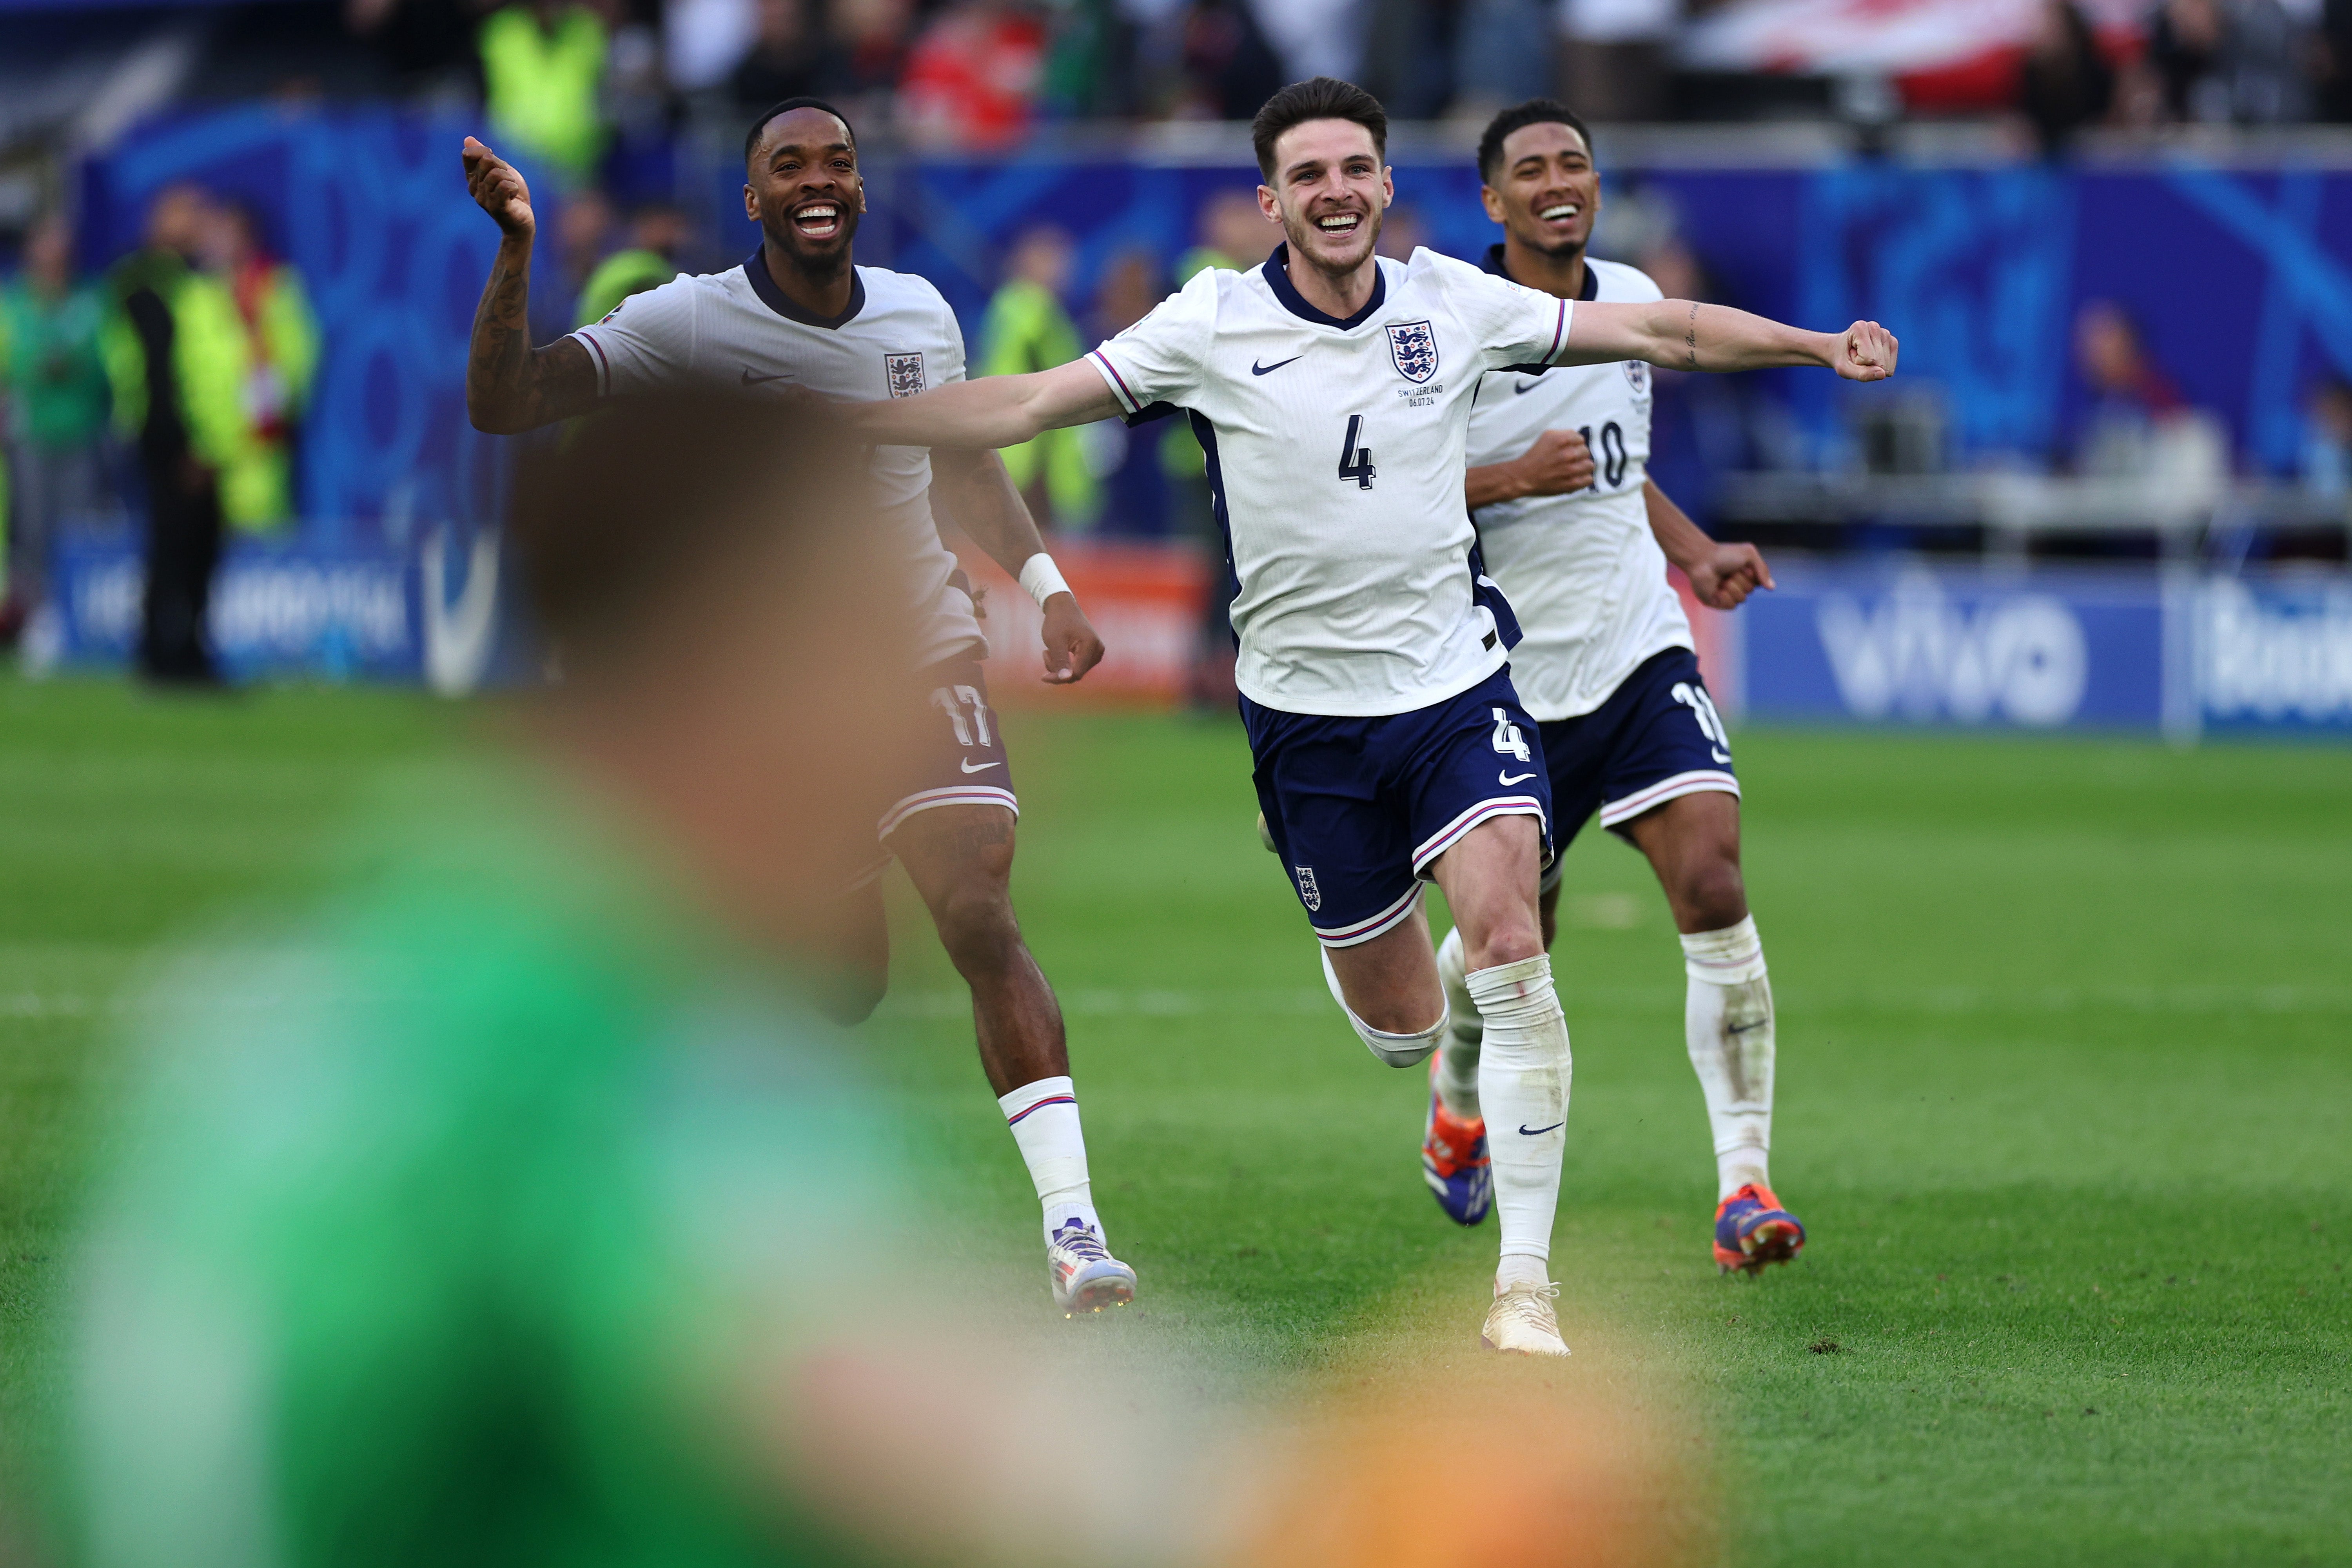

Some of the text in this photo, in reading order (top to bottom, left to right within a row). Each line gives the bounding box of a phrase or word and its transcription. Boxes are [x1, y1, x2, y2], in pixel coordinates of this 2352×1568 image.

[1397, 385, 1443, 397] SWITZERLAND
[1409, 397, 1434, 407] 06.07.24
[1338, 414, 1376, 490] 4
[929, 684, 991, 747] 17
[1492, 707, 1531, 762] 4
